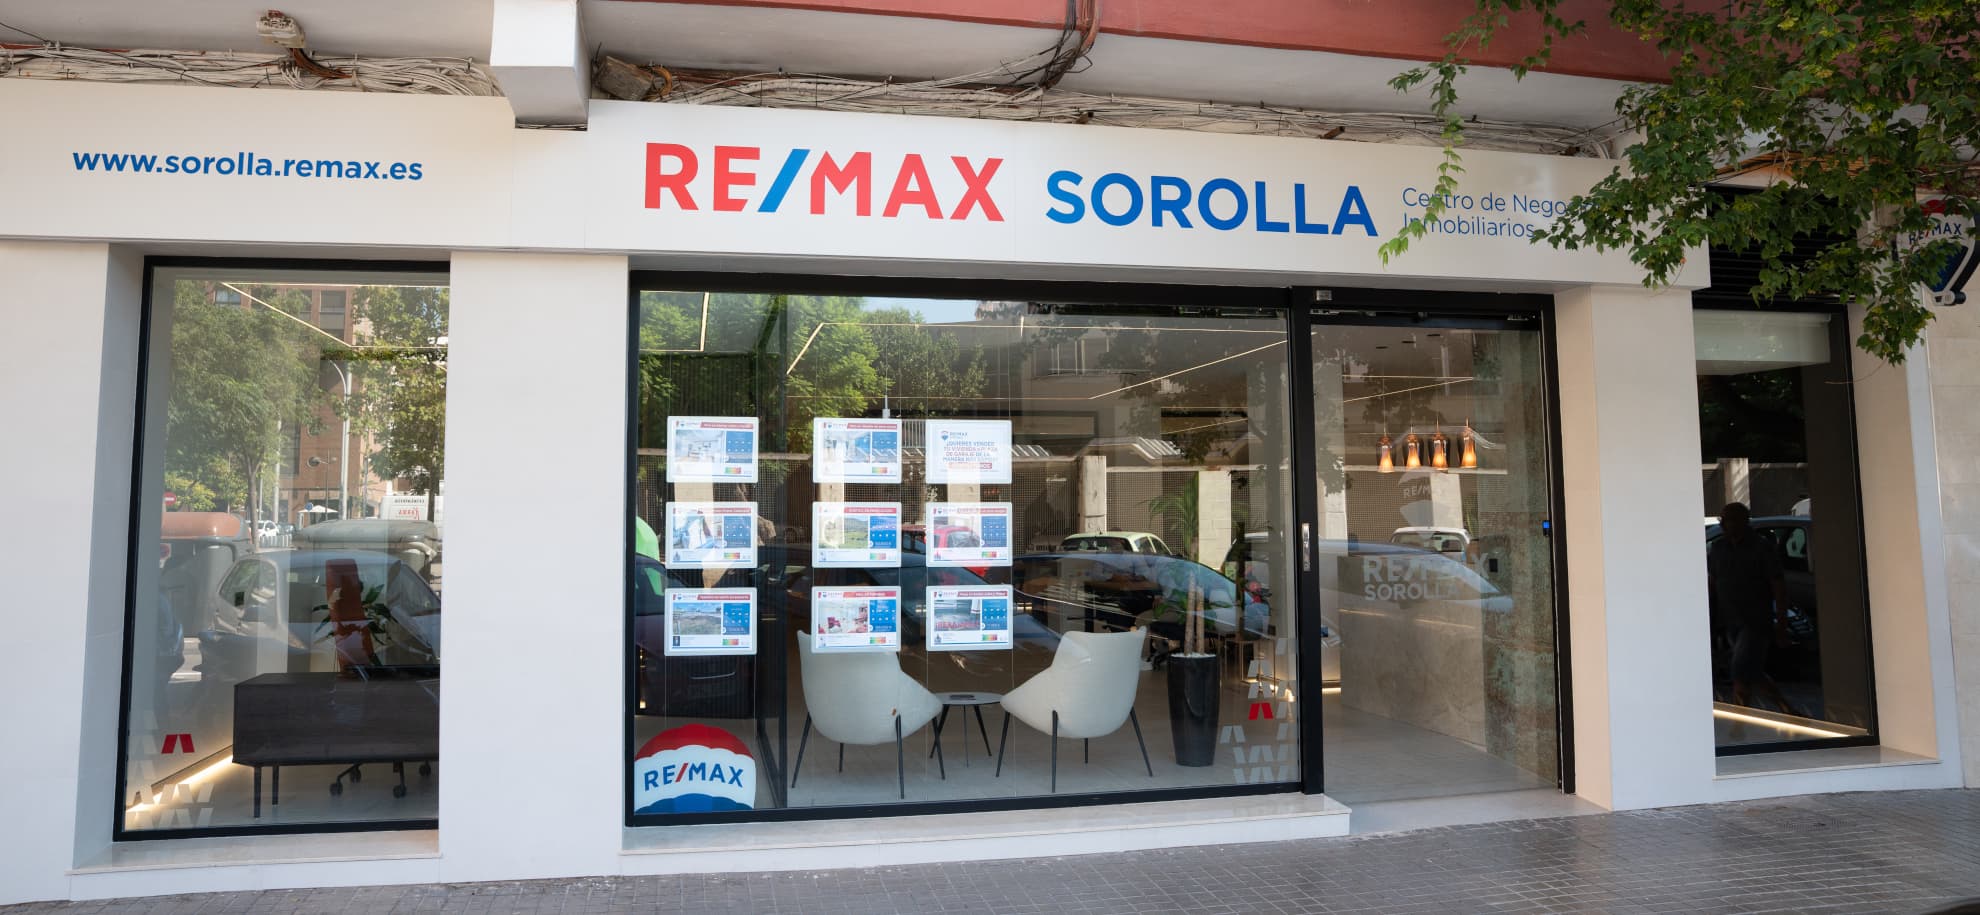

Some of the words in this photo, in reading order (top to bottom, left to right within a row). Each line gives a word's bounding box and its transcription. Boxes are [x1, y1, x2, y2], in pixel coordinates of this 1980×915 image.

[72, 151, 424, 181] www.sorolla.remax.es
[645, 142, 1005, 222] RE/MAX
[1044, 170, 1379, 238] SOROLLA
[1480, 192, 1506, 213] de
[1513, 194, 1579, 218] Nego
[644, 762, 744, 792] RE/MAX
